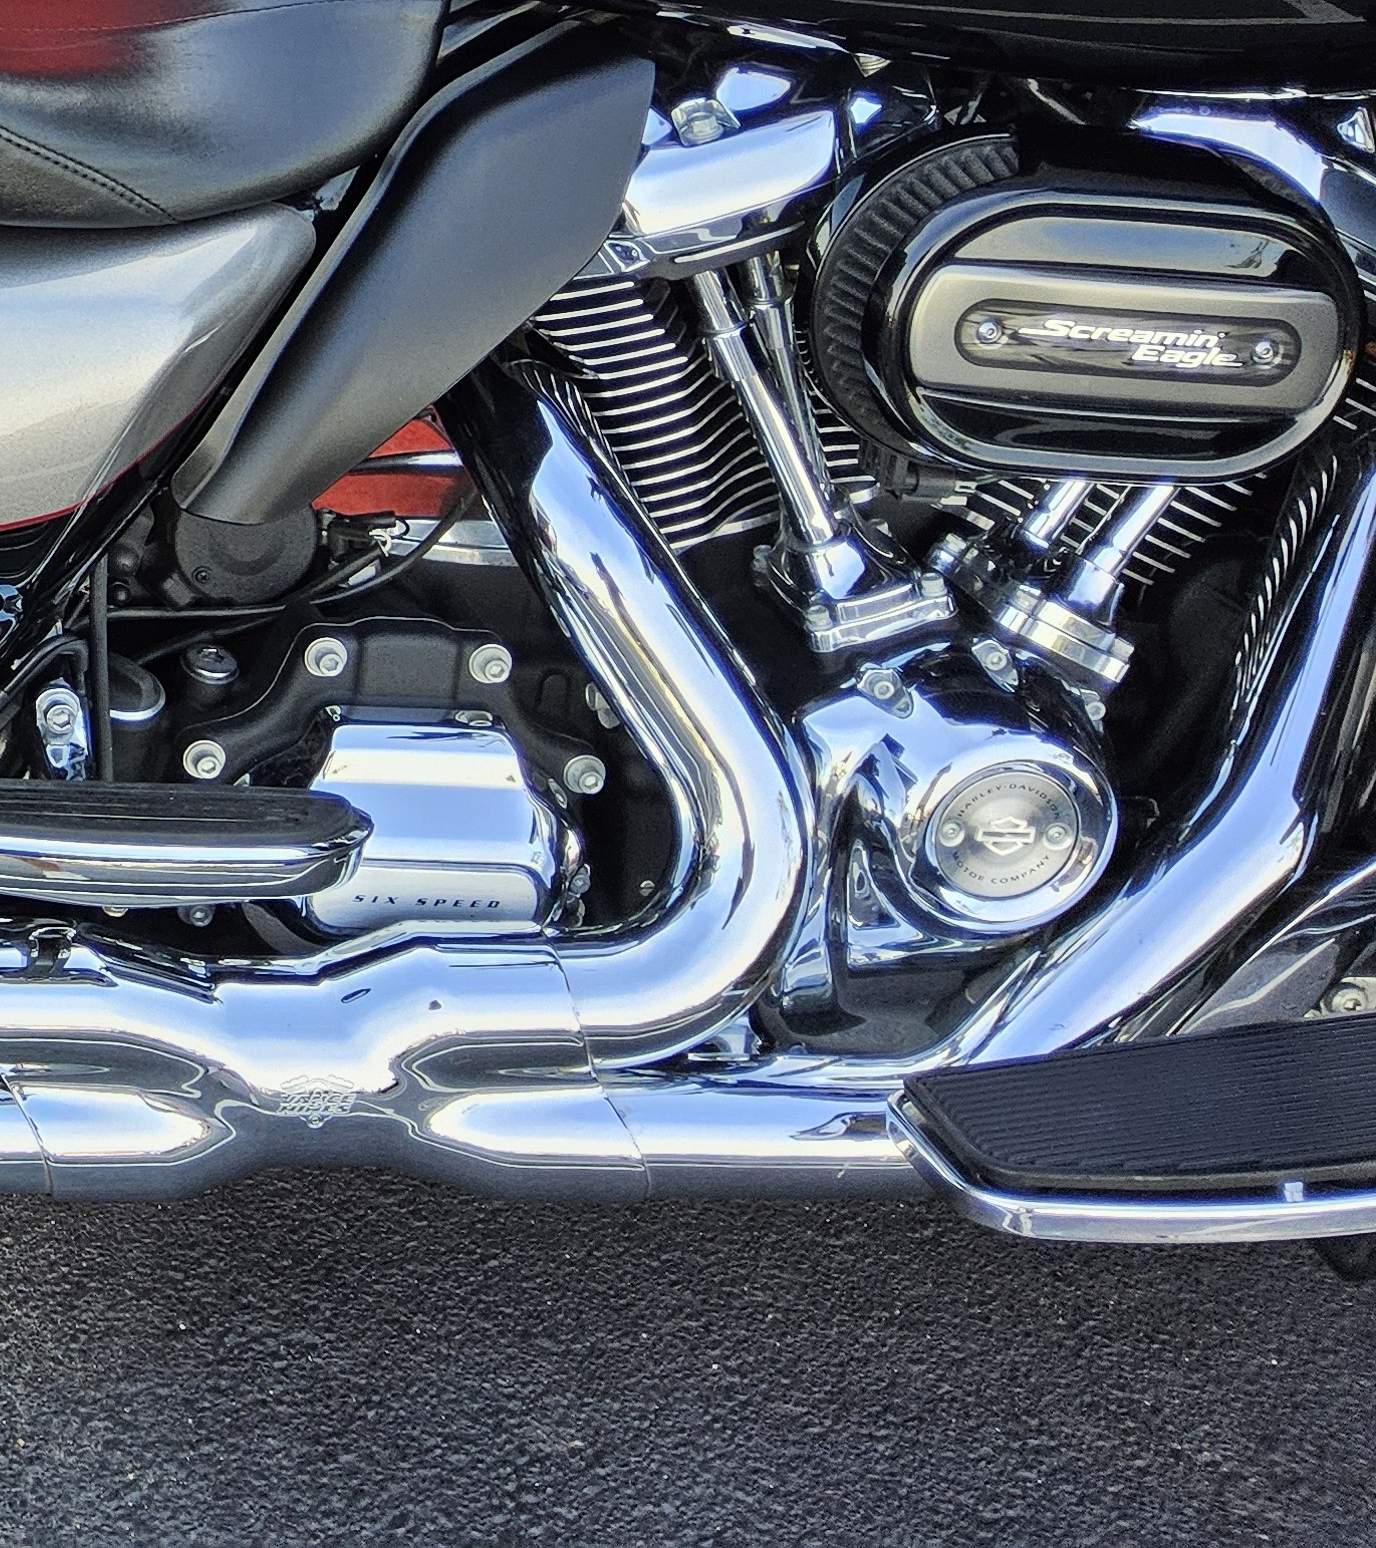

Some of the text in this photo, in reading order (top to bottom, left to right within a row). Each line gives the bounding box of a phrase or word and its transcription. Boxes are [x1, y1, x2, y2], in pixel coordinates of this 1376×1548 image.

[1132, 344, 1243, 368] Eagle
[957, 782, 1061, 819] HARLEY-DAVIDSON
[952, 851, 1051, 884] MOTOR COMPANY
[352, 894, 501, 908] SIX SPEED
